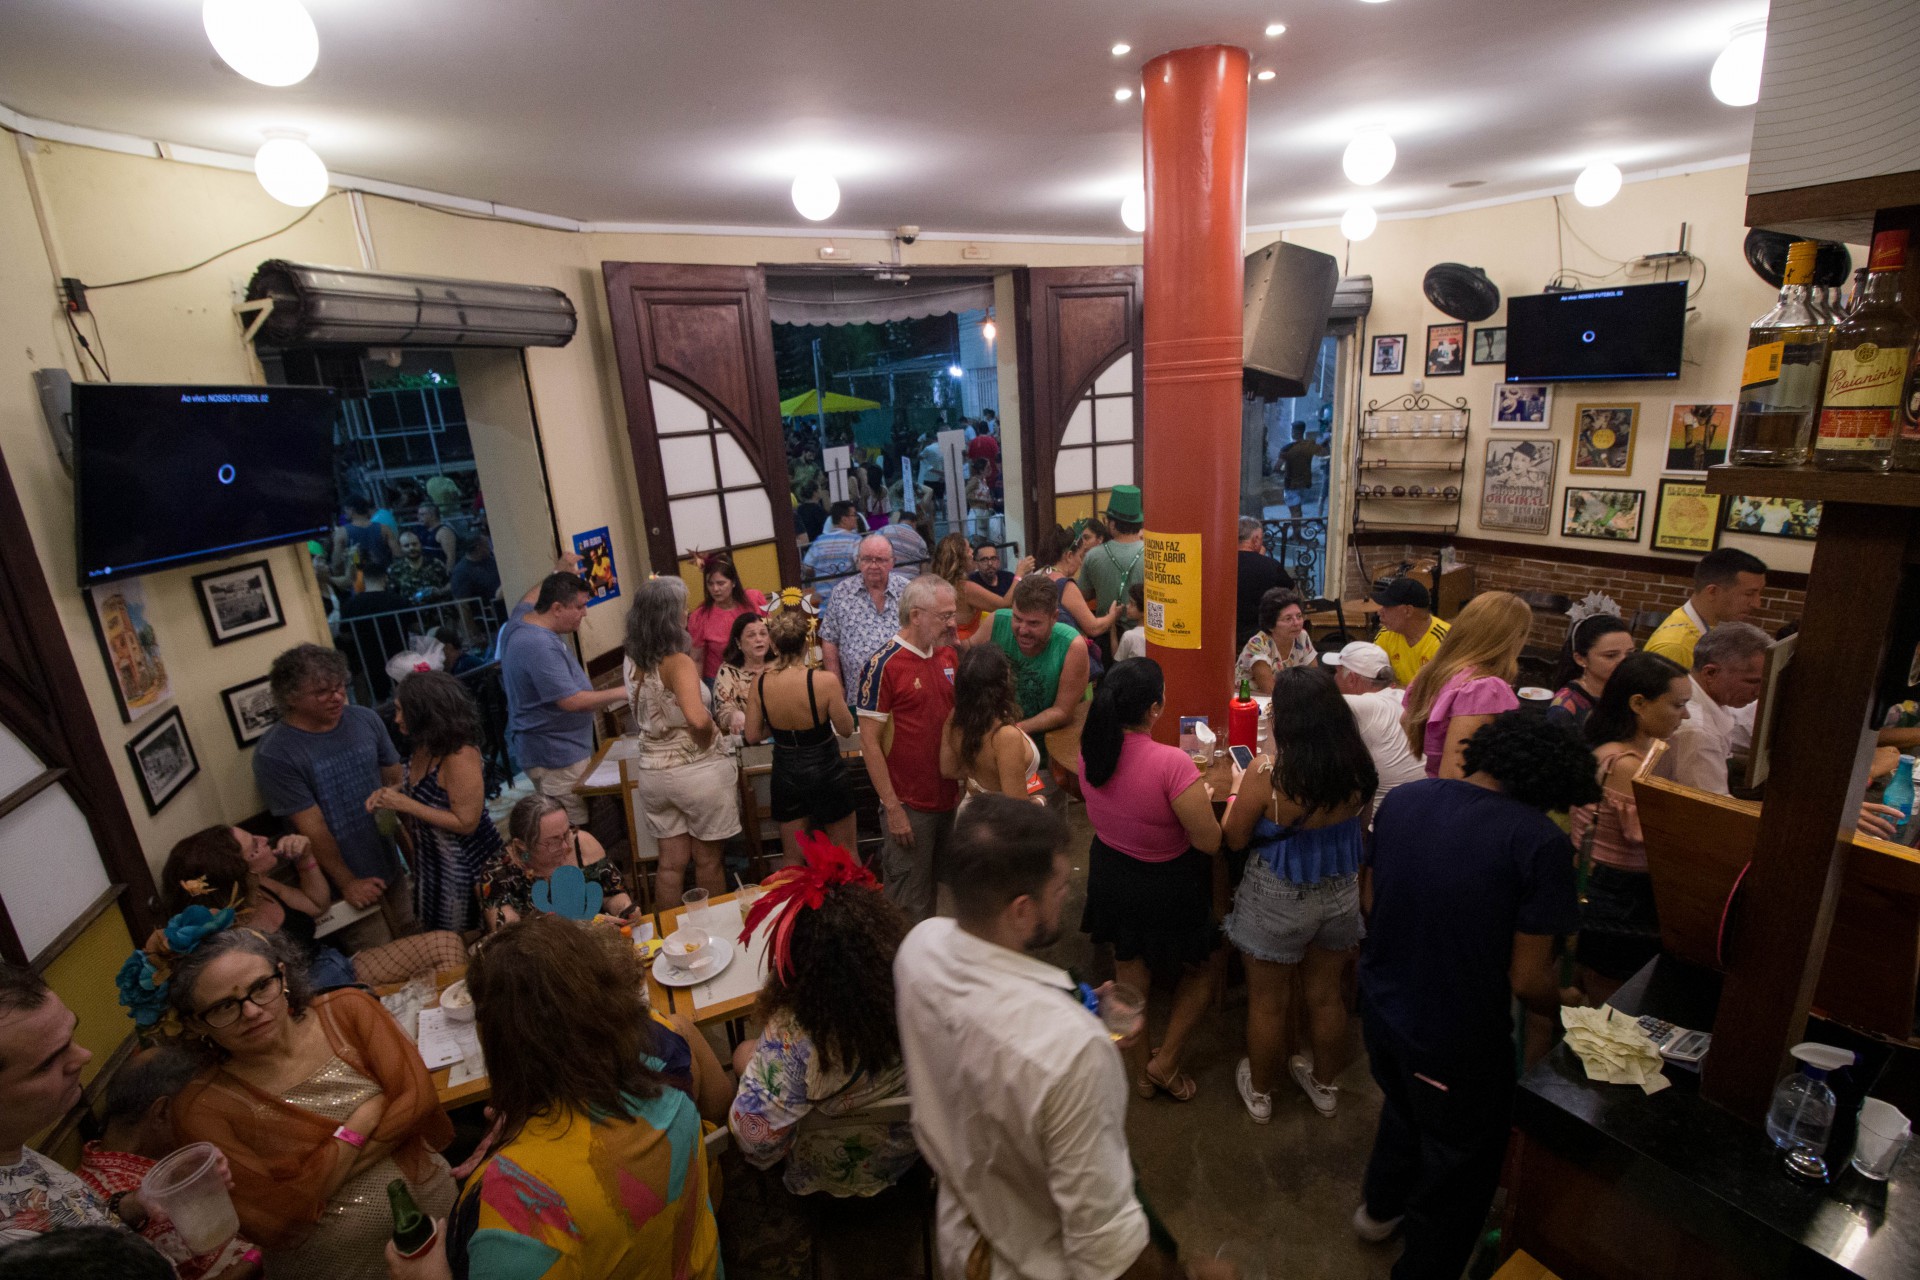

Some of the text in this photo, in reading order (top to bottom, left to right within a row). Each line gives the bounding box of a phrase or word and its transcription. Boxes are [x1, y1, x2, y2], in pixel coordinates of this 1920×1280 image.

[1829, 366, 1902, 394] Praianinha
[181, 393, 192, 403] Ao
[207, 393, 231, 403] NOSSO
[231, 393, 260, 403] FUTEBOL
[1486, 493, 1547, 507] ORIGINAL
[1165, 541, 1180, 552] FAZ
[1163, 552, 1186, 563] ABRIR
[1154, 562, 1166, 573] VEZ
[1154, 572, 1183, 585] PORTAS.
